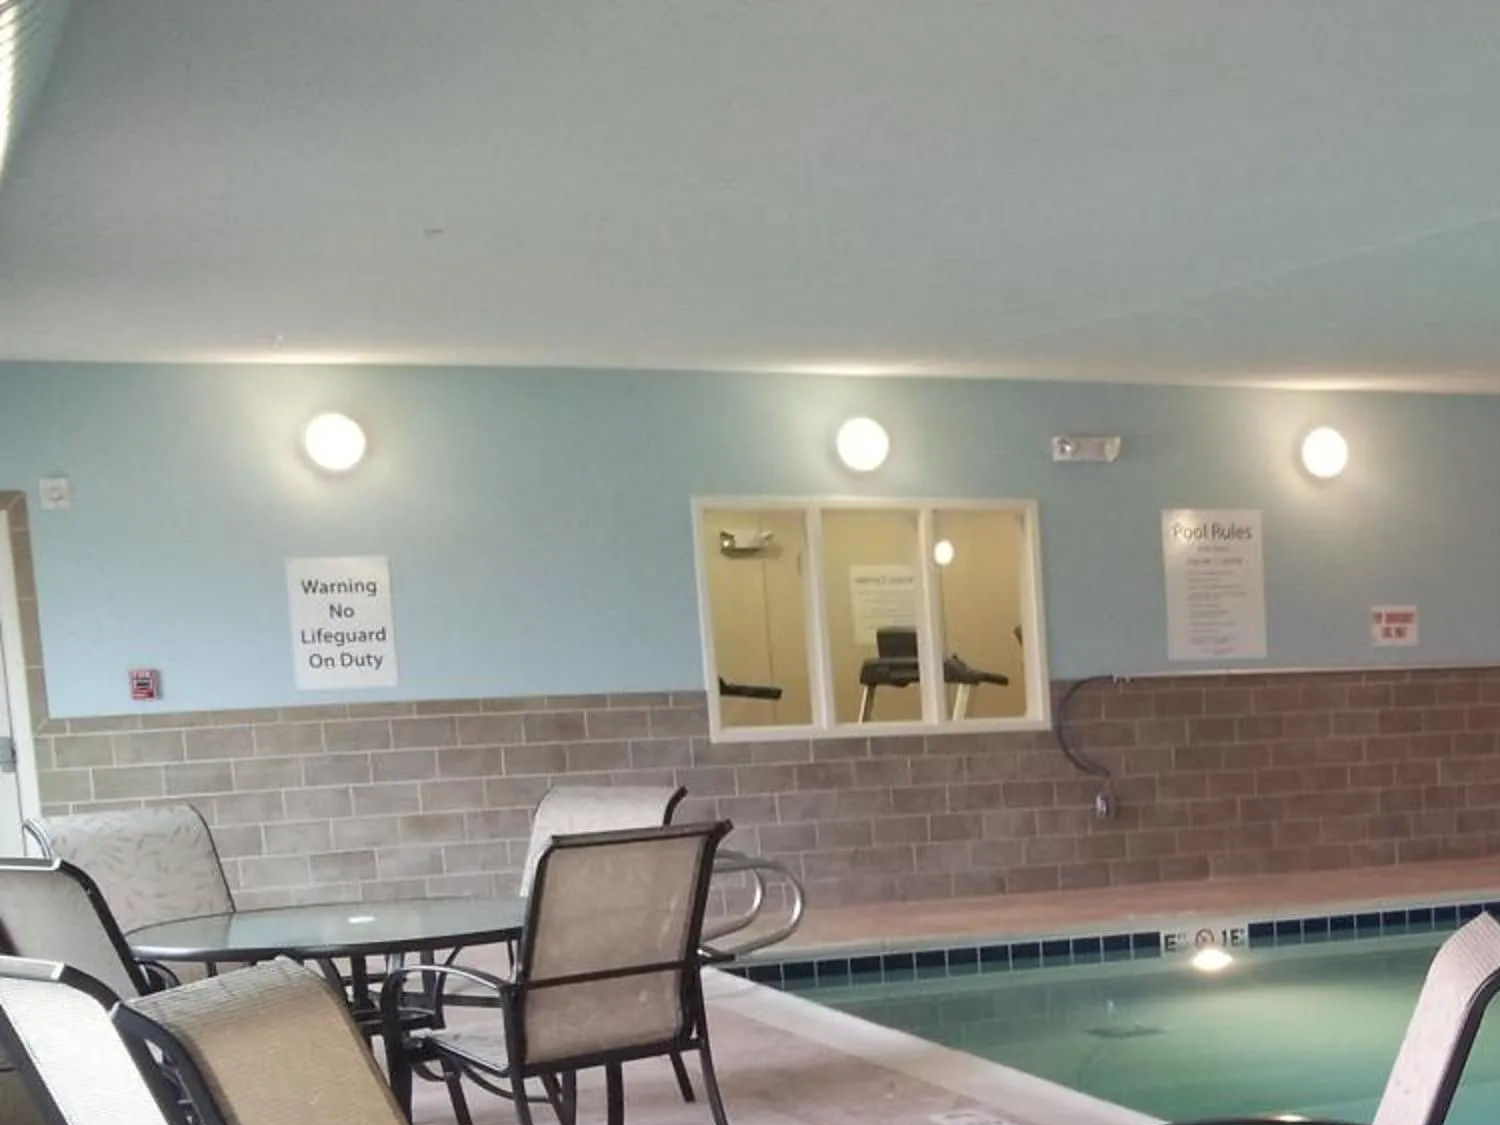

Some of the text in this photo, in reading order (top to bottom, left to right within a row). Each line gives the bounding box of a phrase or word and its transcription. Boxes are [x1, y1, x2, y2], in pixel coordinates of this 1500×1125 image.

[1173, 522, 1254, 541] Pool Rules
[301, 579, 377, 596] Warning
[329, 604, 355, 618] No
[301, 626, 387, 646] Lifeguard
[309, 652, 383, 669] On Duty
